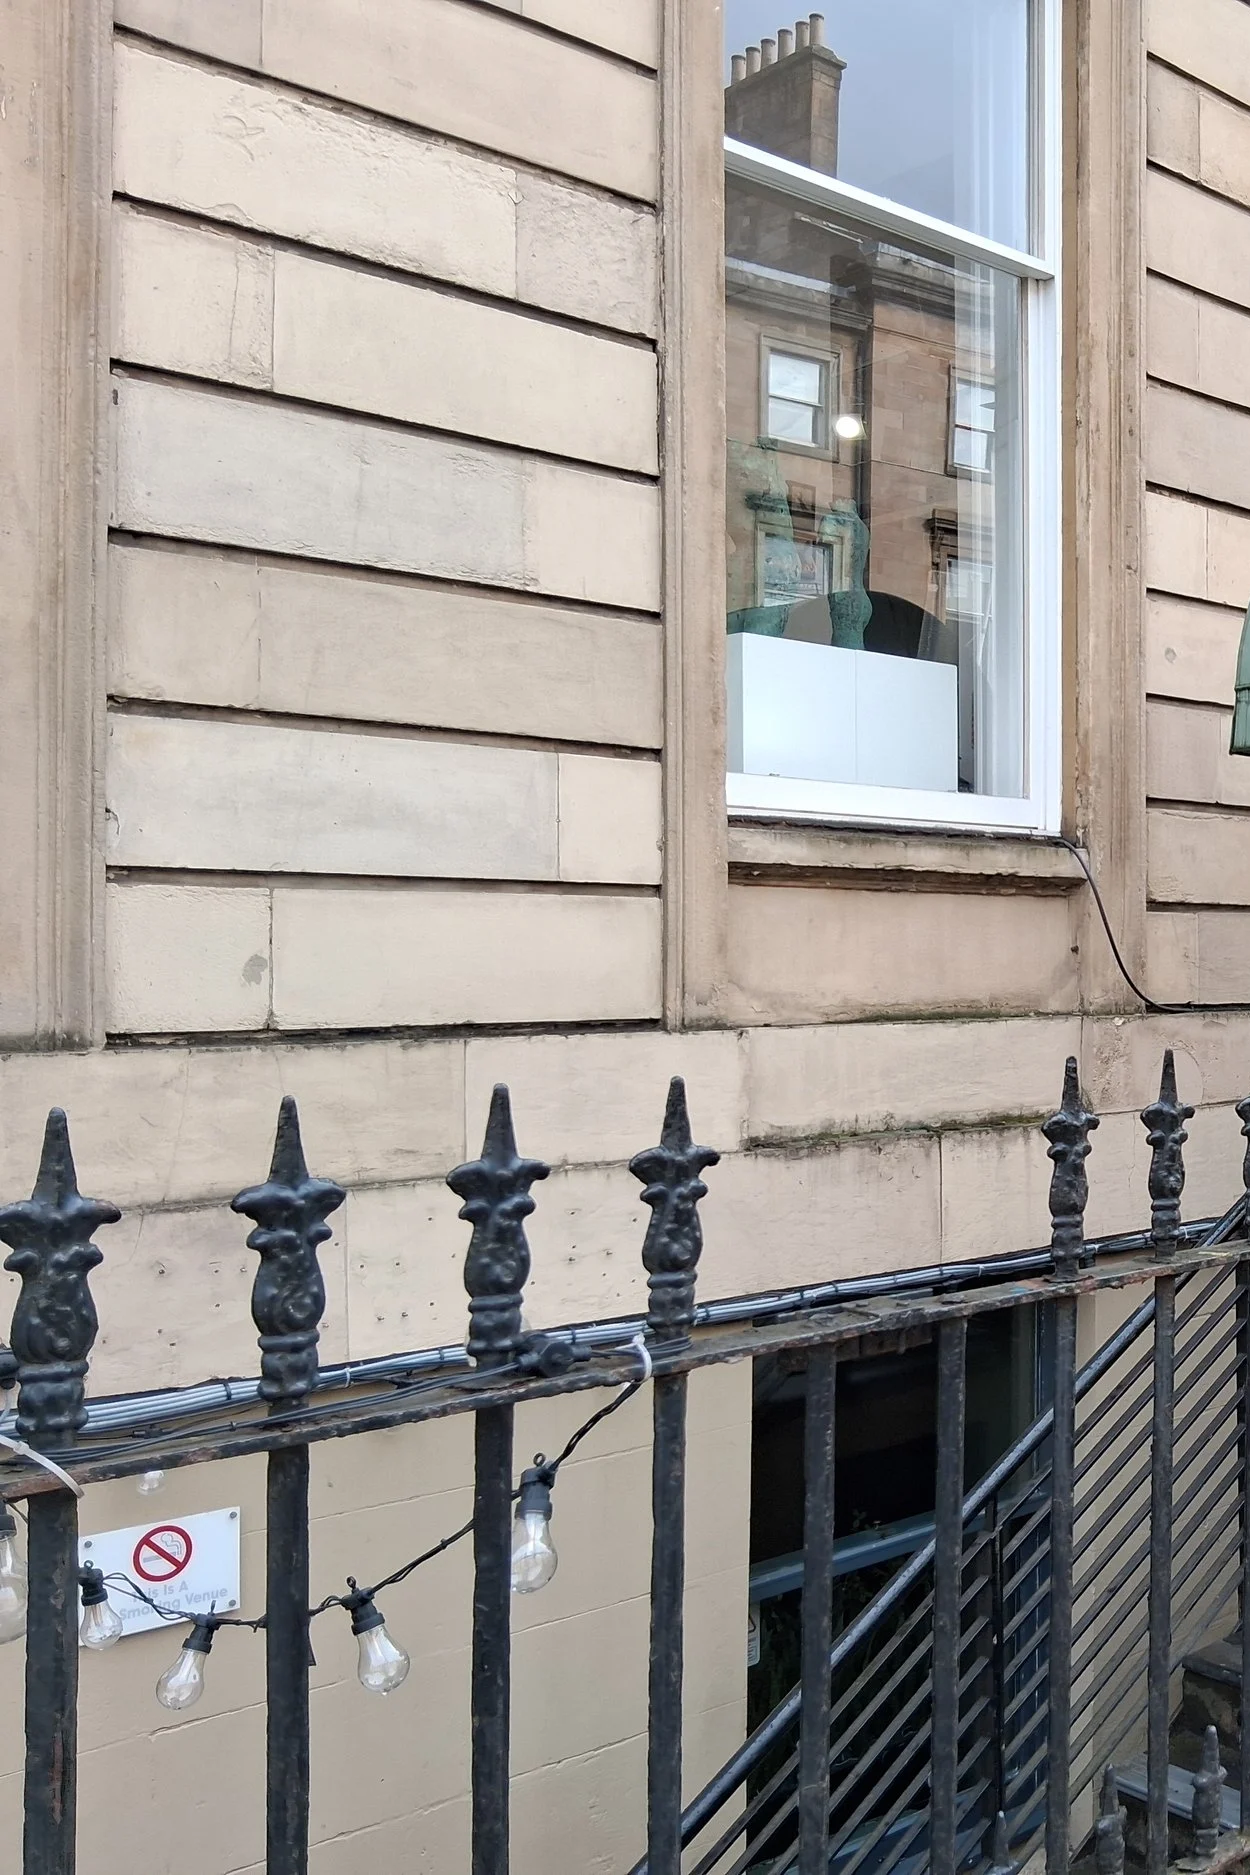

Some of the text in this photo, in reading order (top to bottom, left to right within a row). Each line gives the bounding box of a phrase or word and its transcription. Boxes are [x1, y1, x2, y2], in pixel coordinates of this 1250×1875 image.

[164, 1584, 175, 1596] Is
[179, 1580, 188, 1593] A
[120, 1587, 228, 1621] Smoing Venue
